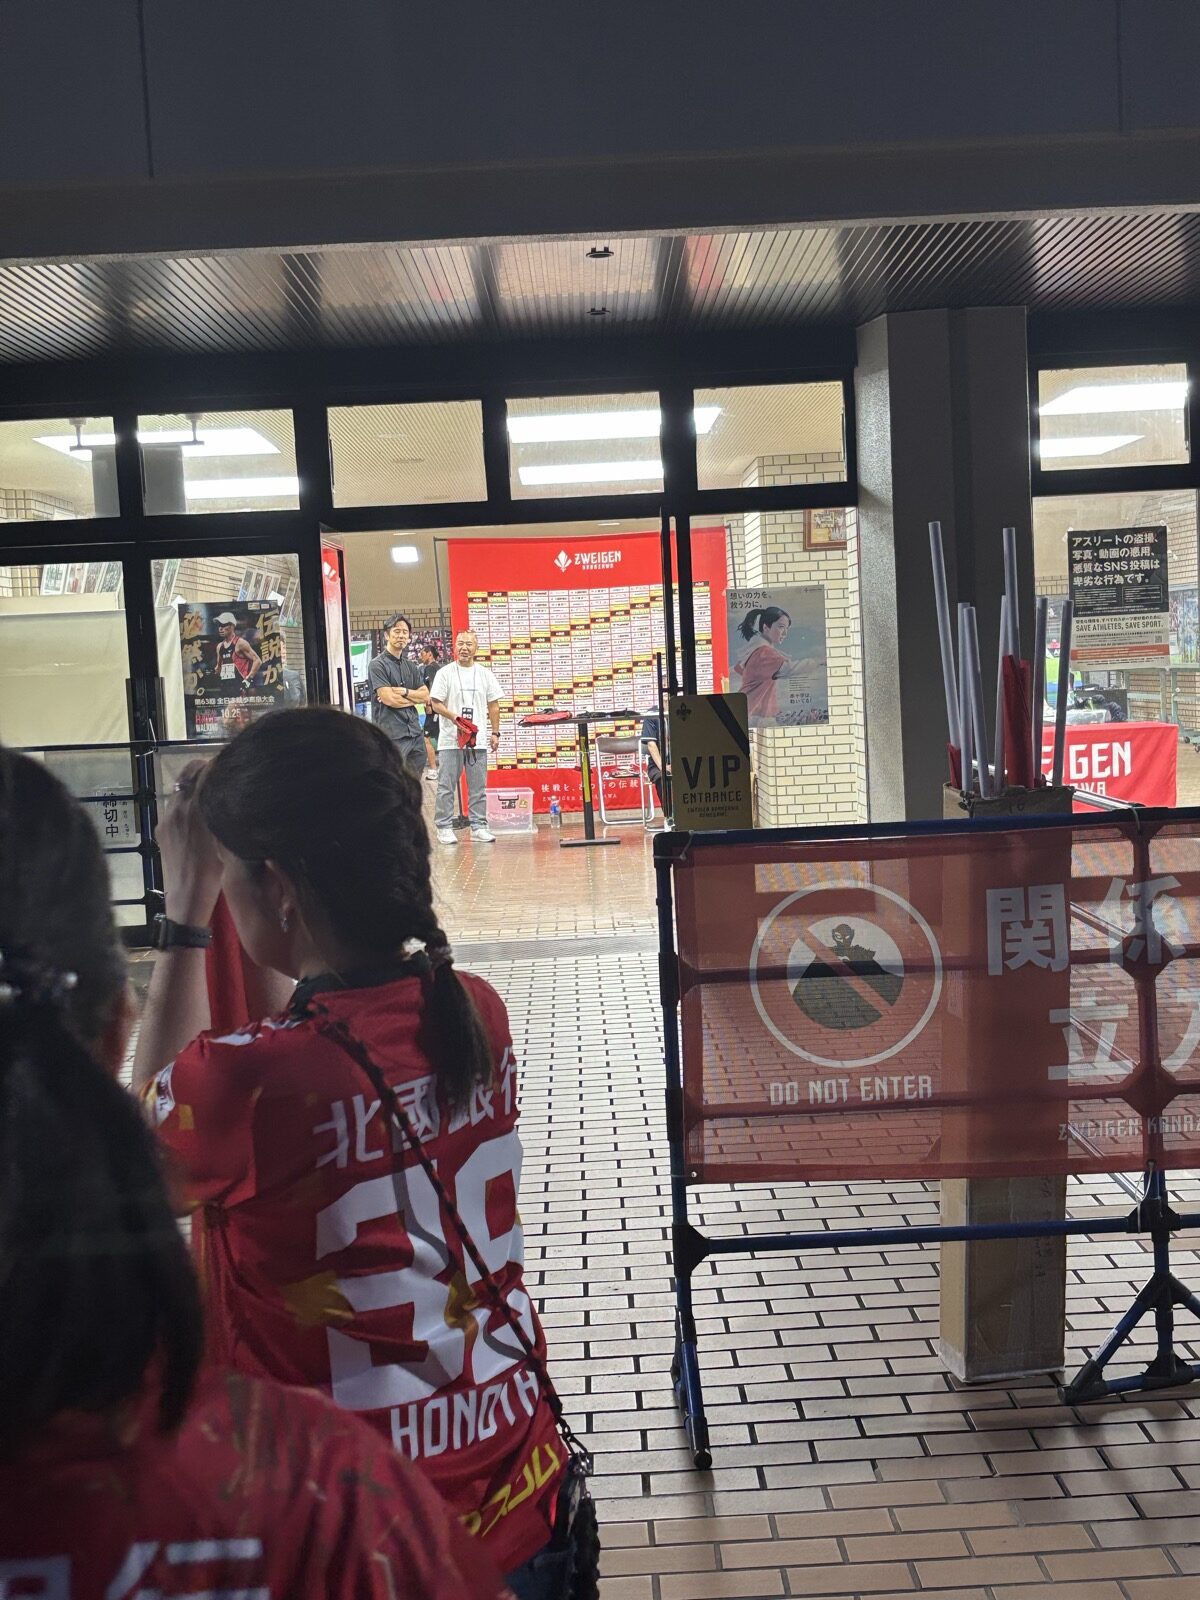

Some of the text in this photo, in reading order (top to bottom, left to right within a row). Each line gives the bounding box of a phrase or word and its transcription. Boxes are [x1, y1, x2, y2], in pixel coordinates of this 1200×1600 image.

[574, 551, 621, 566] ZWEIGEN
[1076, 624, 1091, 632] SAVE
[1125, 621, 1140, 630] SAVE
[1142, 620, 1164, 628] SPORT.
[681, 754, 741, 790] VIP
[682, 790, 742, 804] ENTRANCE
[986, 876, 1186, 976] 関係
[770, 1075, 932, 1106] DO NOT ENTER
